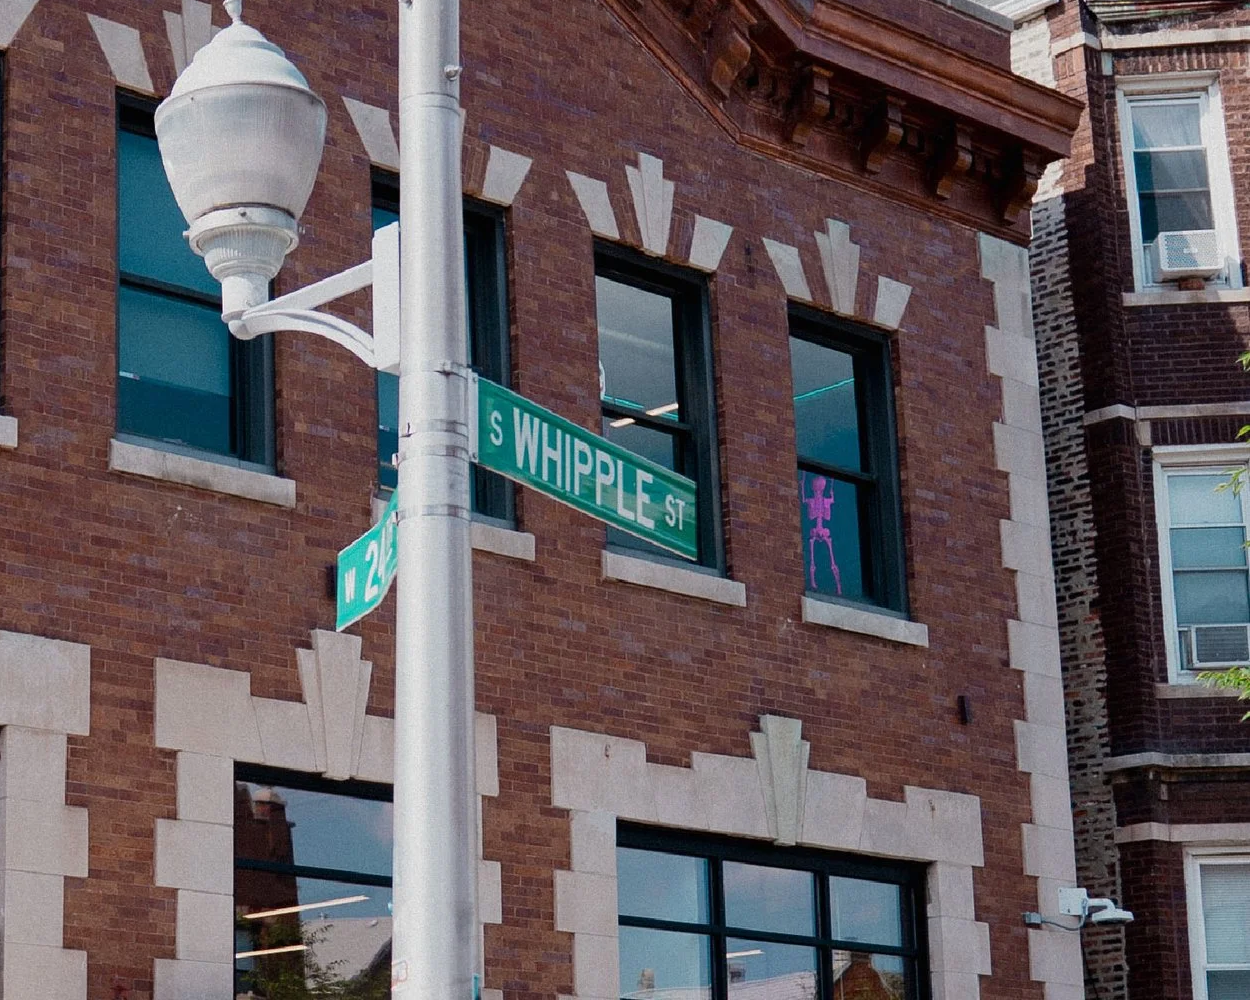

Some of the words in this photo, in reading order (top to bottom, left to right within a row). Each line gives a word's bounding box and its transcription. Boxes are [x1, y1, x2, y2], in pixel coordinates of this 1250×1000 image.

[490, 410, 503, 446] S
[513, 406, 655, 530] WHIPPLE
[665, 494, 686, 531] ST
